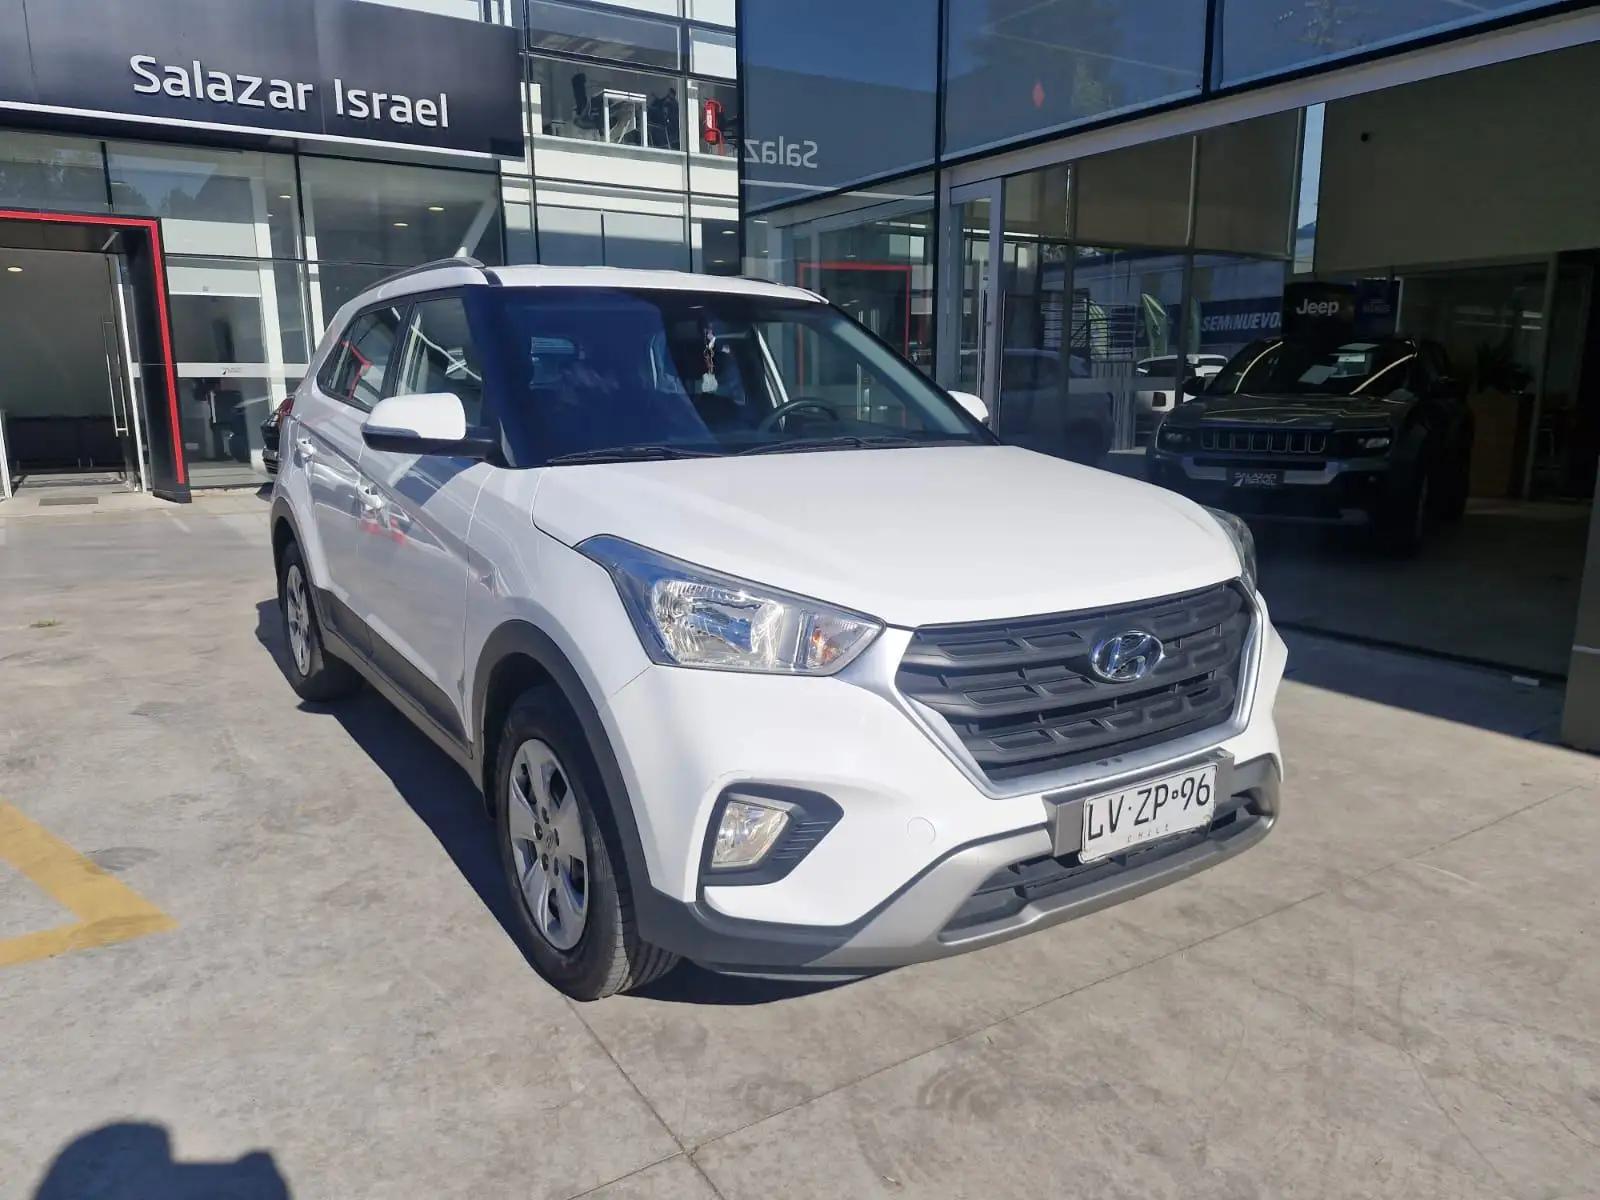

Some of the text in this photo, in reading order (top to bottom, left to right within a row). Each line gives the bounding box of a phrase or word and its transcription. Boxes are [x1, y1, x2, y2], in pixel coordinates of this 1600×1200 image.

[130, 54, 449, 128] Salazar Israel
[1296, 298, 1340, 316] Jeep
[1201, 311, 1282, 332] SEMINUEVO
